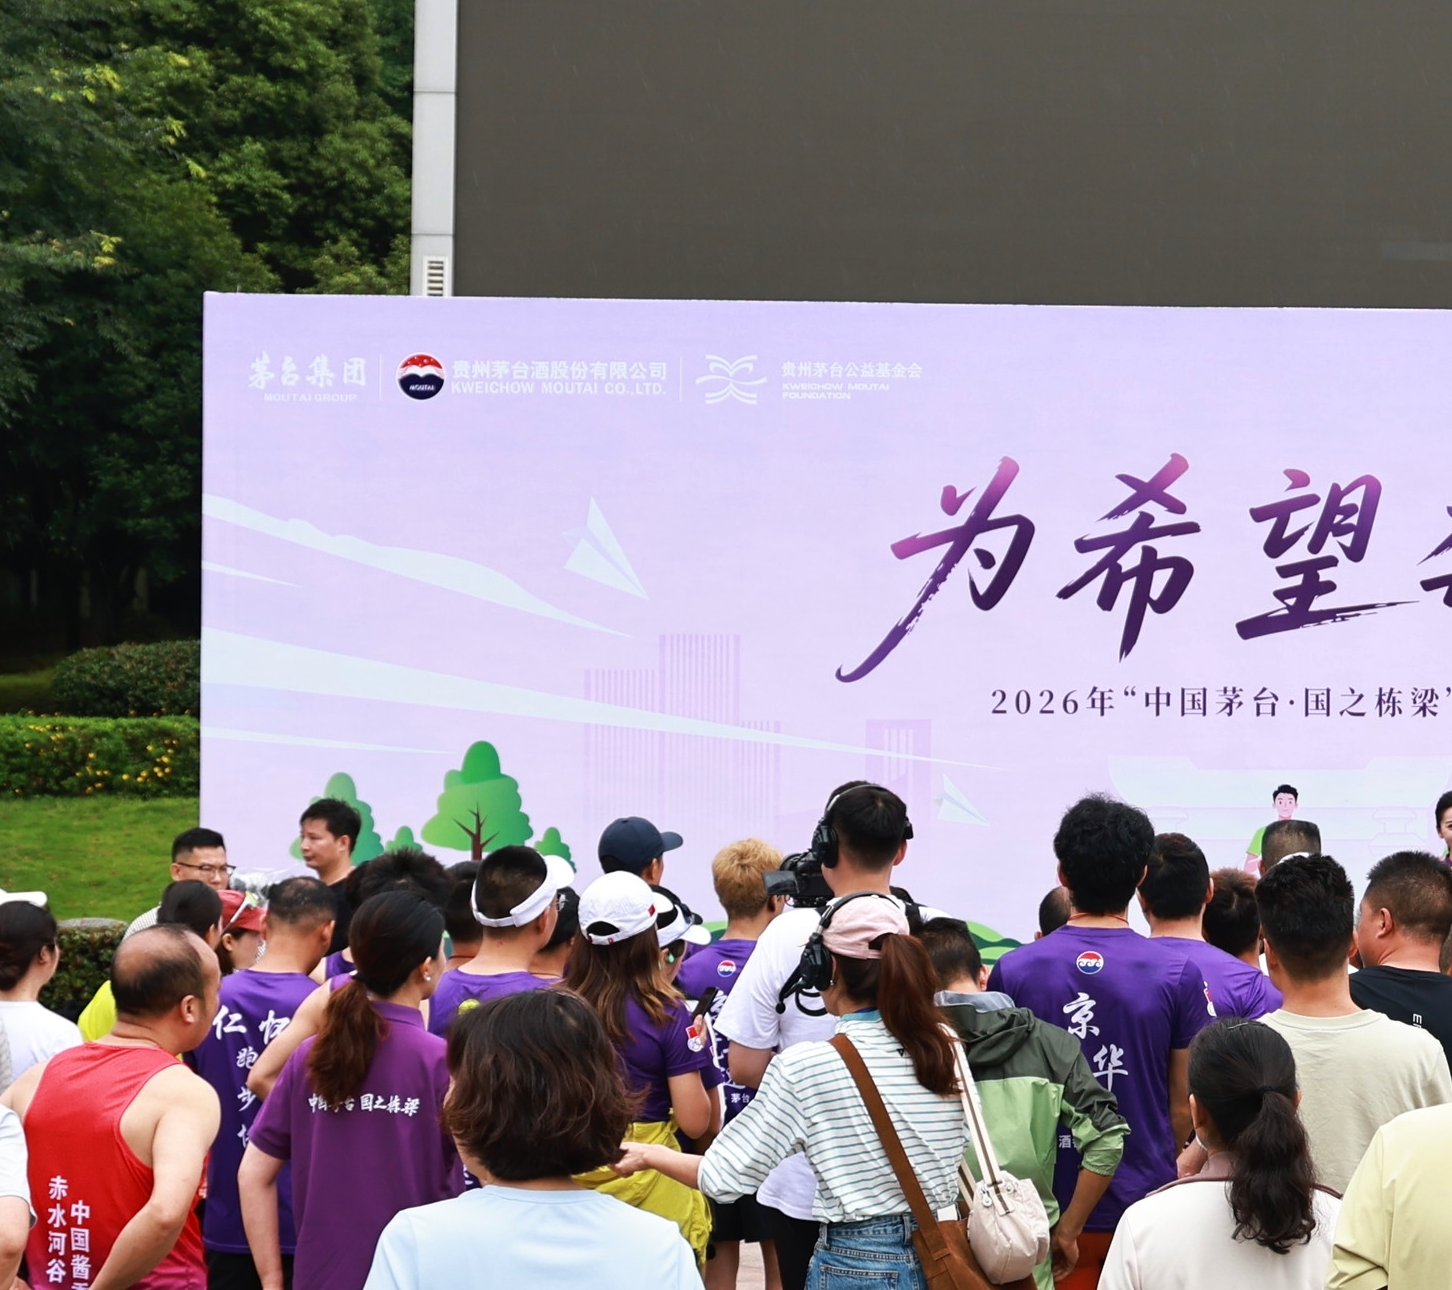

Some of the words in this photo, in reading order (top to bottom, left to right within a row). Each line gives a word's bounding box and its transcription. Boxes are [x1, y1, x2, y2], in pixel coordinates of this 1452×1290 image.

[247, 351, 366, 390] 茅台集团
[451, 360, 667, 380] 贵州茅台酒股份有限公司
[781, 361, 923, 378] 贵州茅台公益基金会
[264, 393, 312, 402] MOUTAI
[314, 394, 357, 402] GROUP
[451, 381, 534, 394] KWEICHOW
[541, 382, 598, 394] MOUTAI
[604, 382, 667, 396] CO.,LTD.
[46, 1175, 69, 1283] 赤水河谷
